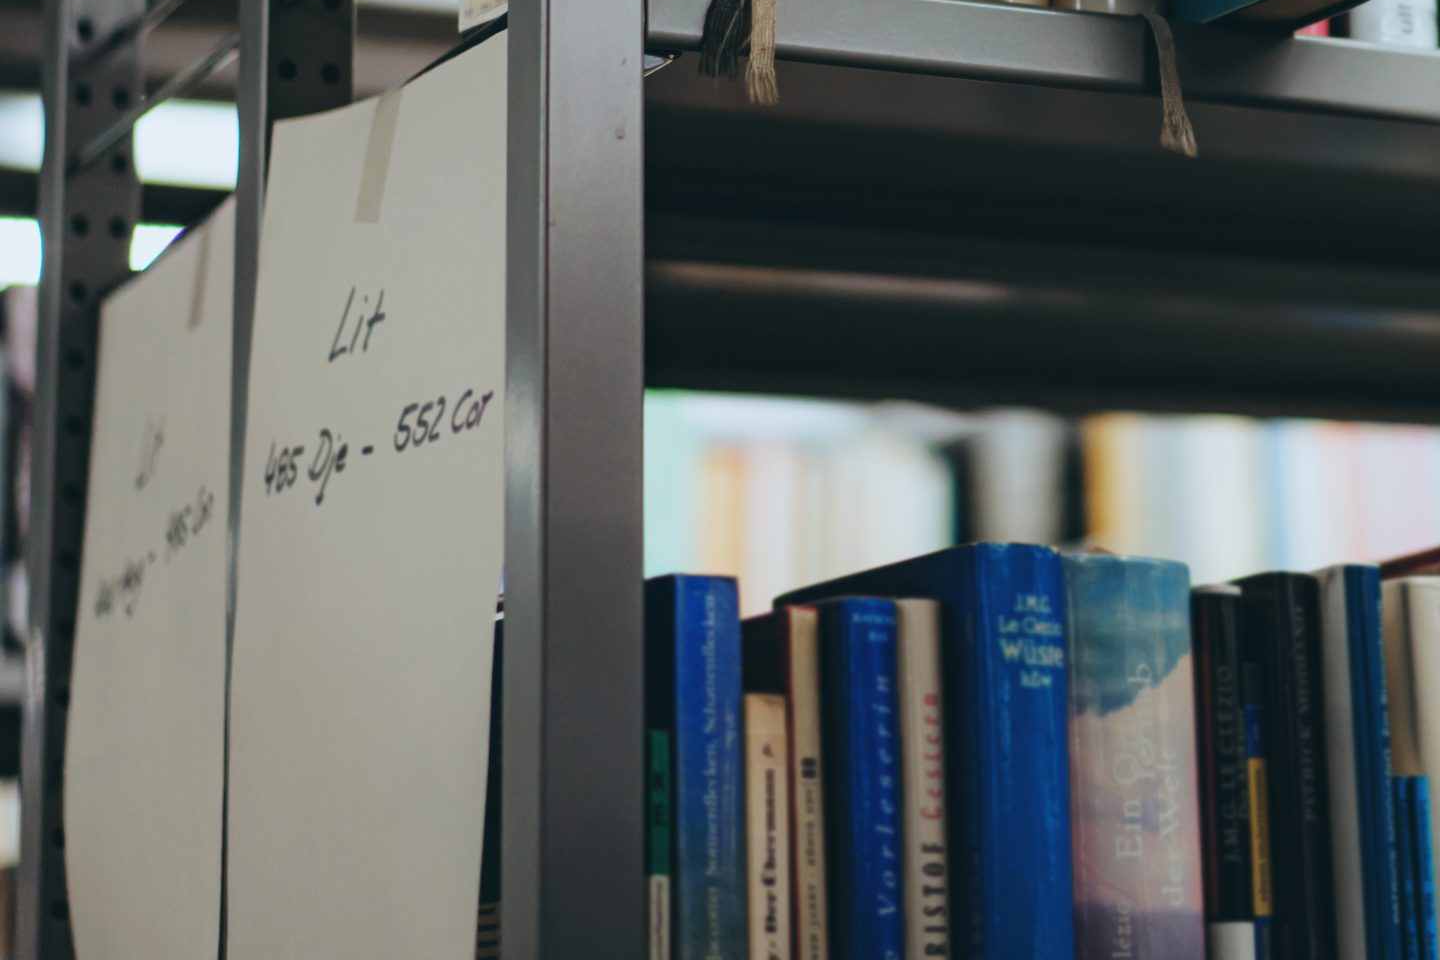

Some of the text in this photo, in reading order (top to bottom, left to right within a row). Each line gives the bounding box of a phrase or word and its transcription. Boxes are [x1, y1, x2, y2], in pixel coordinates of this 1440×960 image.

[328, 286, 386, 363] Lit
[393, 395, 446, 453] 552
[920, 692, 943, 821] Gestern
[872, 674, 898, 917] Vorleserin
[1115, 799, 1143, 860] Ein
[1161, 850, 1184, 908] der
